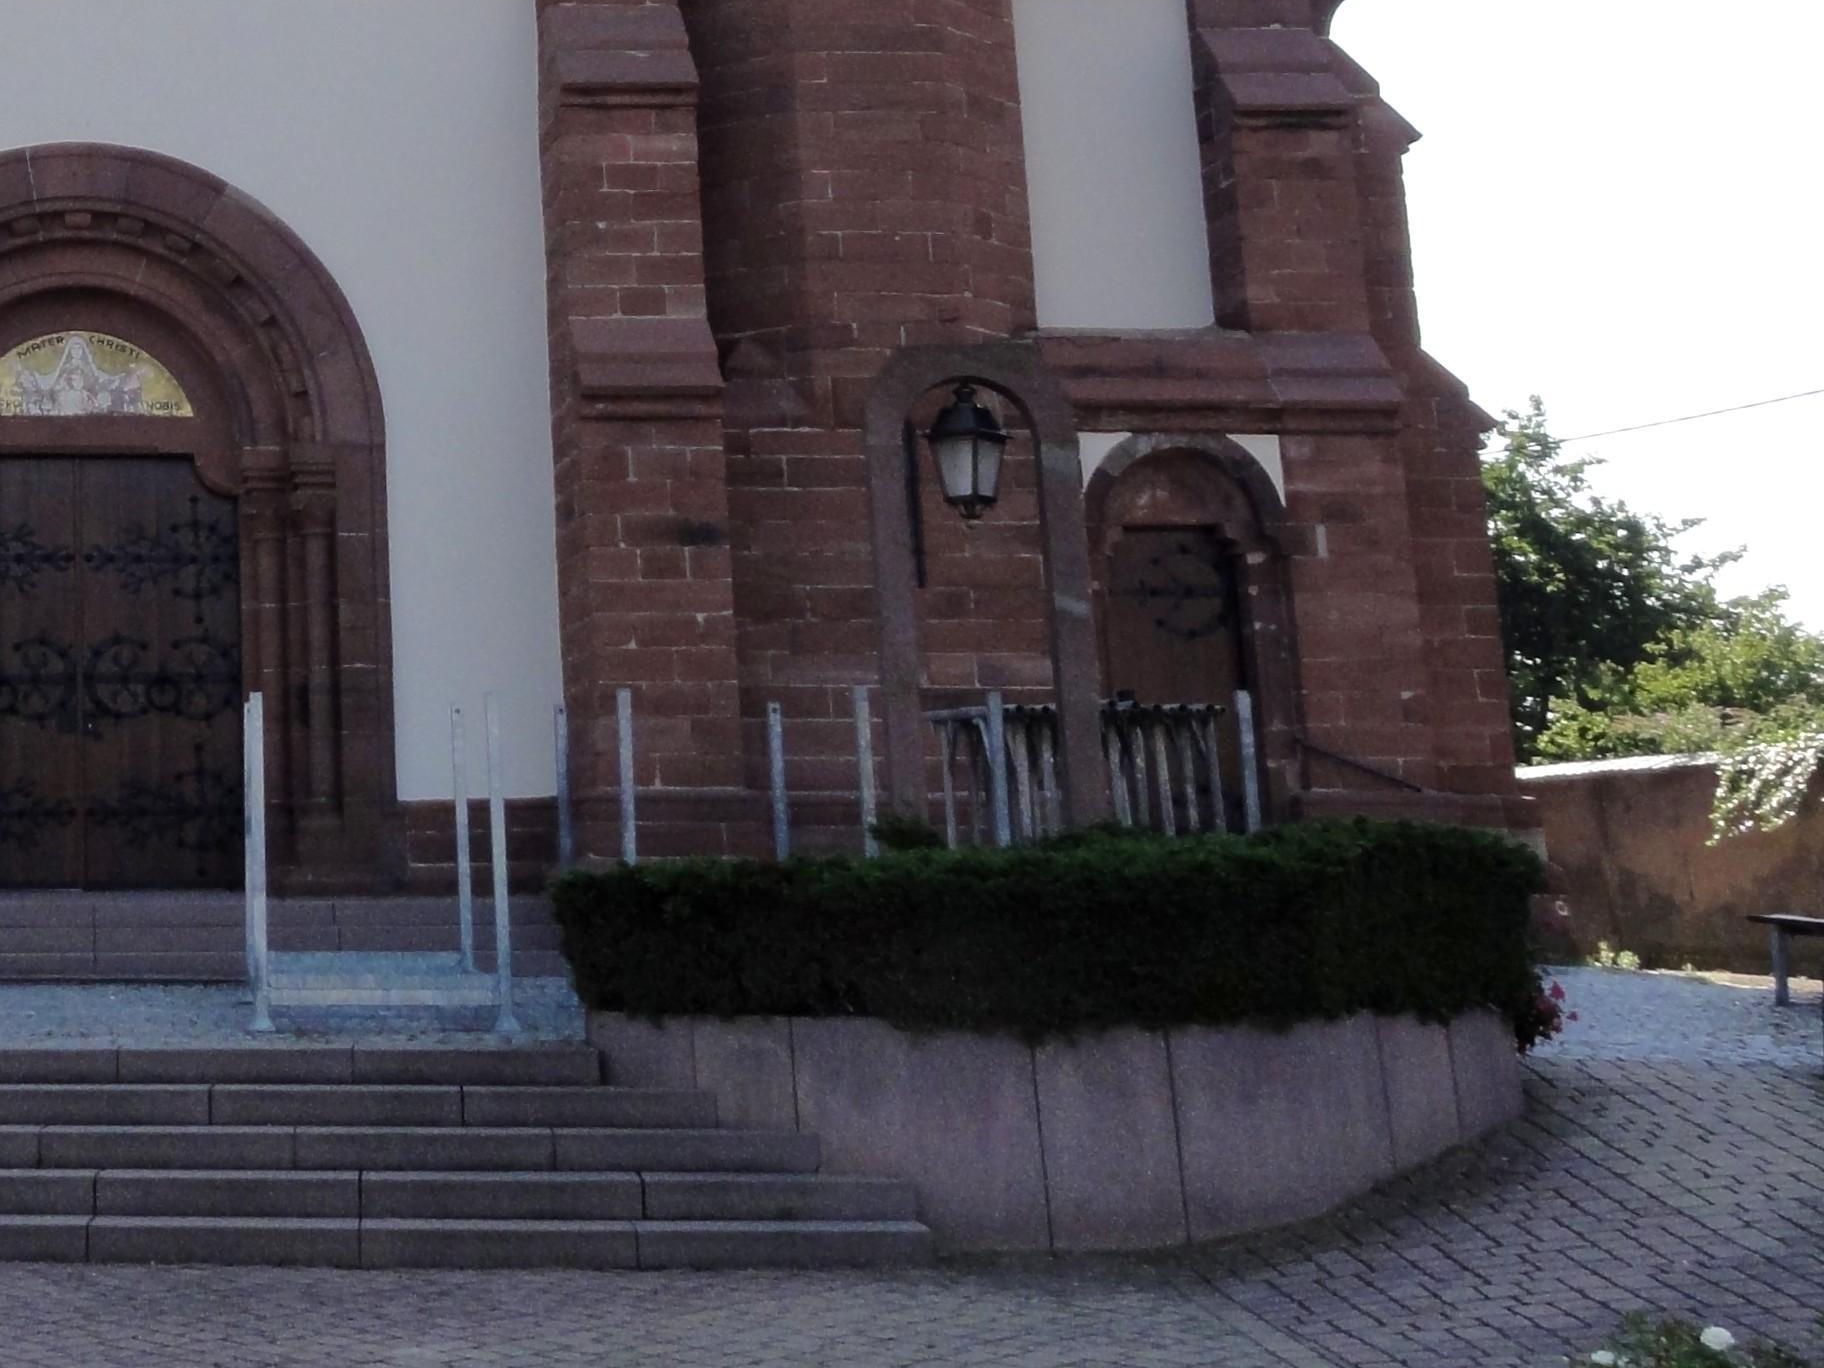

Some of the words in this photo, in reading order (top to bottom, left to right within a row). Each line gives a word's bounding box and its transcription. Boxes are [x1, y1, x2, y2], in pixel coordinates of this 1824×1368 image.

[16, 335, 65, 360] MATER
[88, 335, 141, 360] CHRISTI
[145, 399, 182, 411] NOBIS
